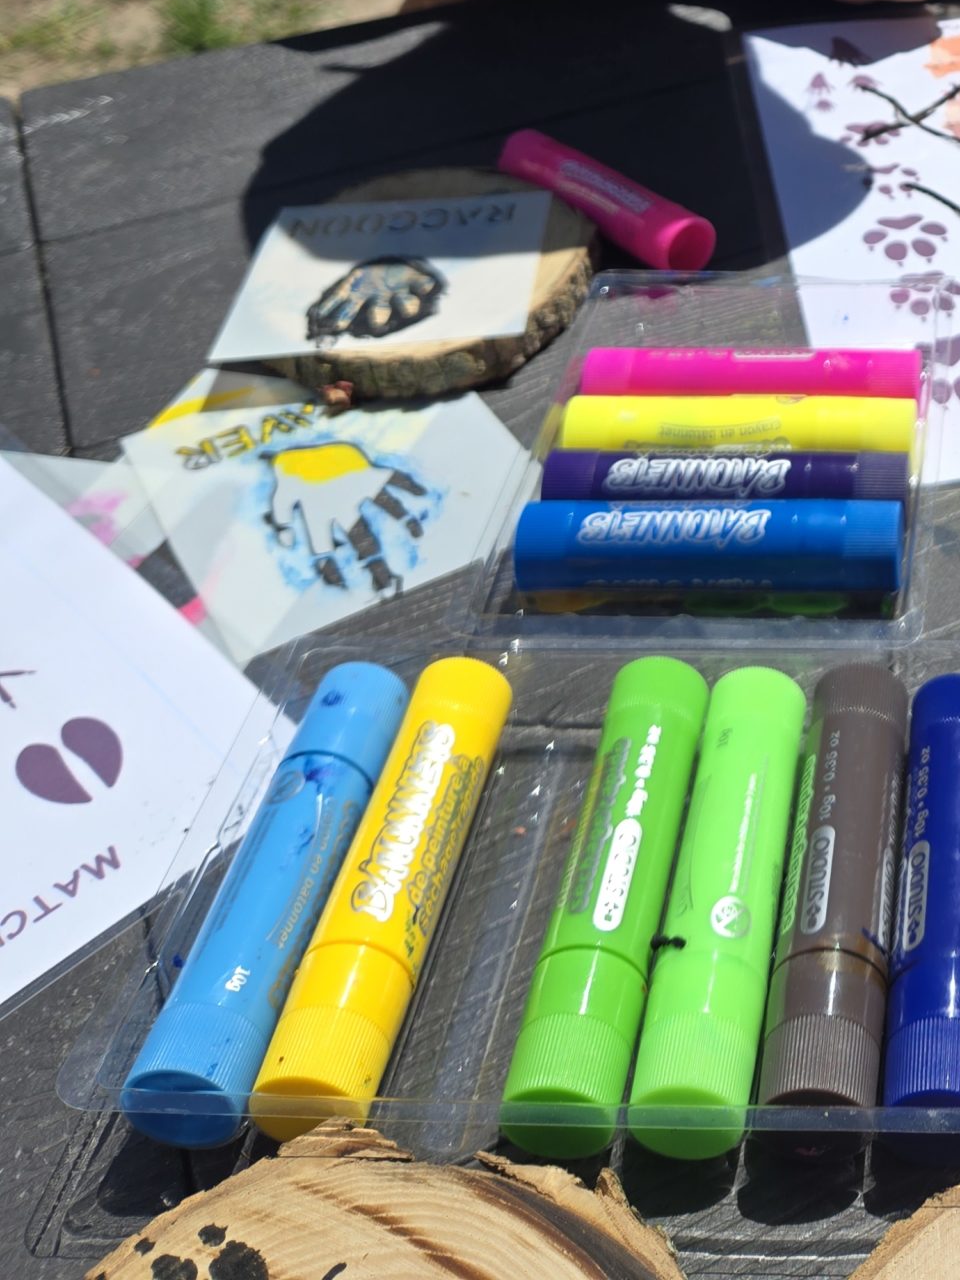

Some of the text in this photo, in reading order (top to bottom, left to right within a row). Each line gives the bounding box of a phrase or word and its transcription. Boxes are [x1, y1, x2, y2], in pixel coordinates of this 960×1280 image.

[288, 202, 518, 238] RACCOON
[830, 730, 841, 746] oz
[818, 792, 836, 821] 10g
[906, 745, 931, 920] STUDIO 10g 0.35 oz
[808, 835, 831, 904] STUDIO
[0, 845, 121, 948] MATC
